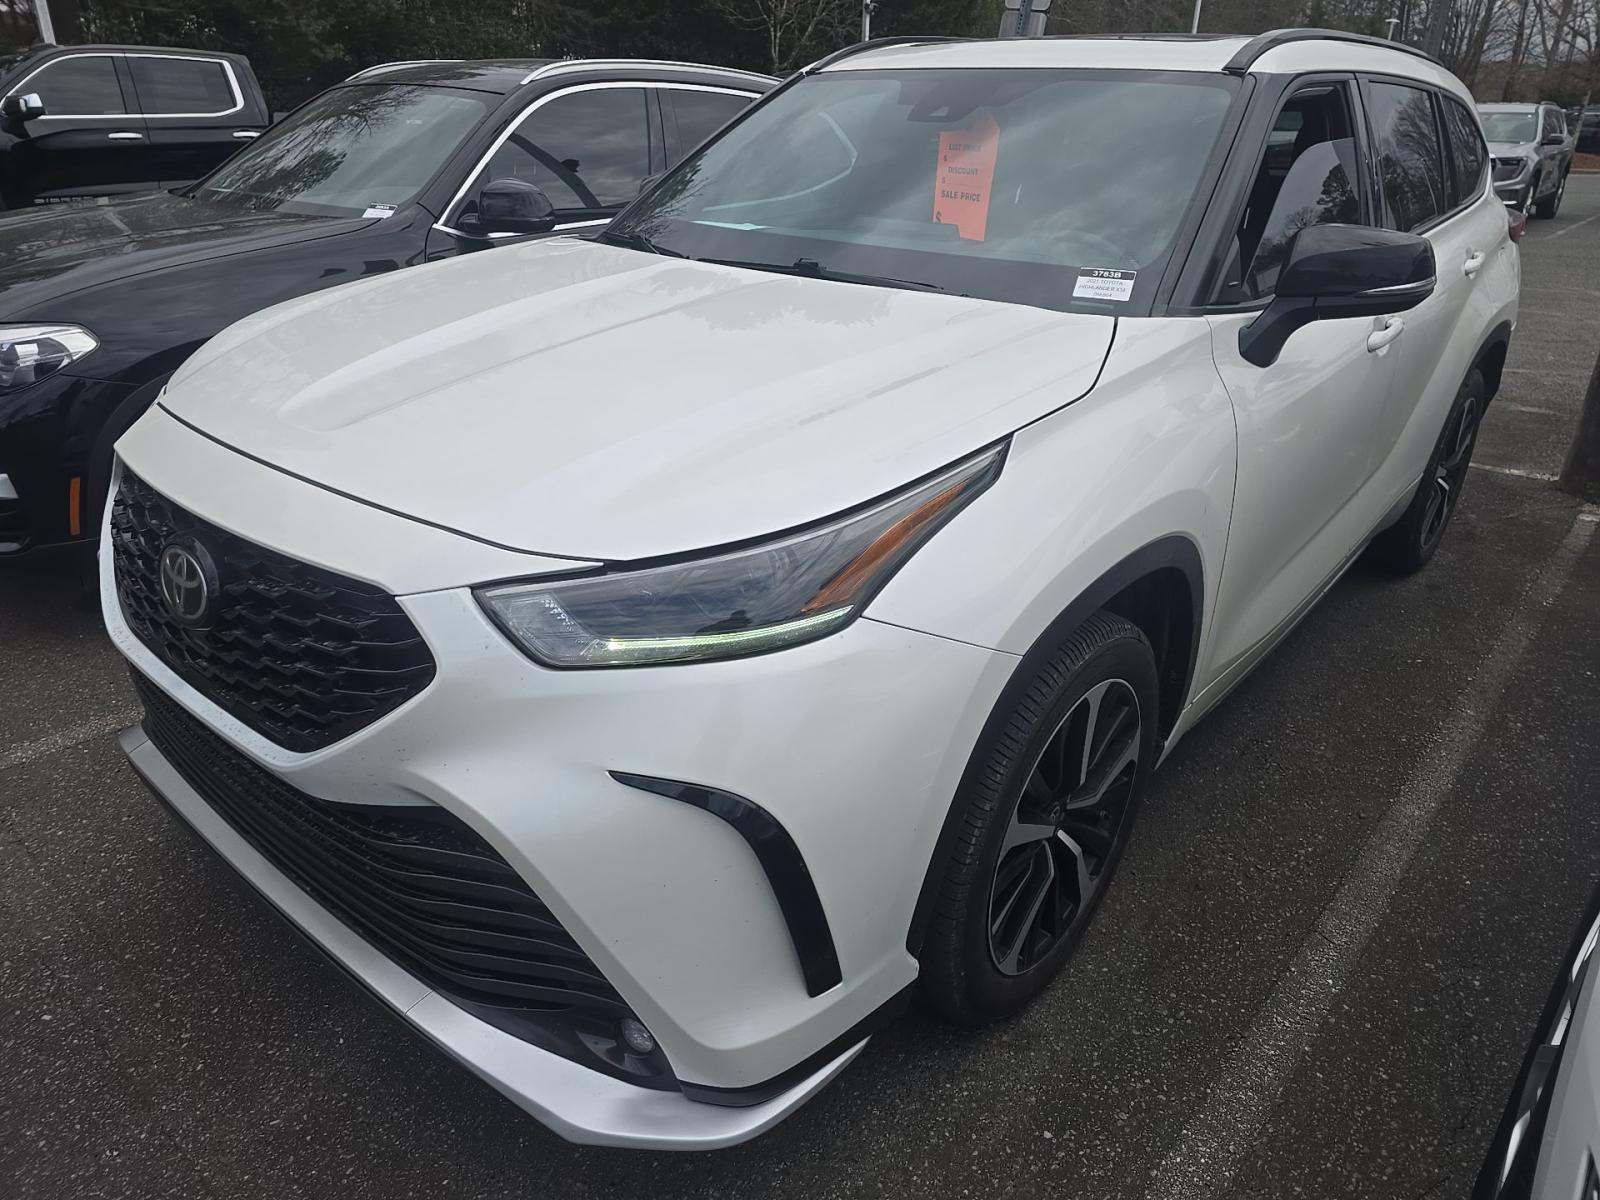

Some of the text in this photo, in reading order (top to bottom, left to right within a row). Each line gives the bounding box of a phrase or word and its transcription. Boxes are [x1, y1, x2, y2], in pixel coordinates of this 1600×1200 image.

[947, 166, 978, 176] DISCOUNT
[941, 190, 981, 202] SALE PRICE
